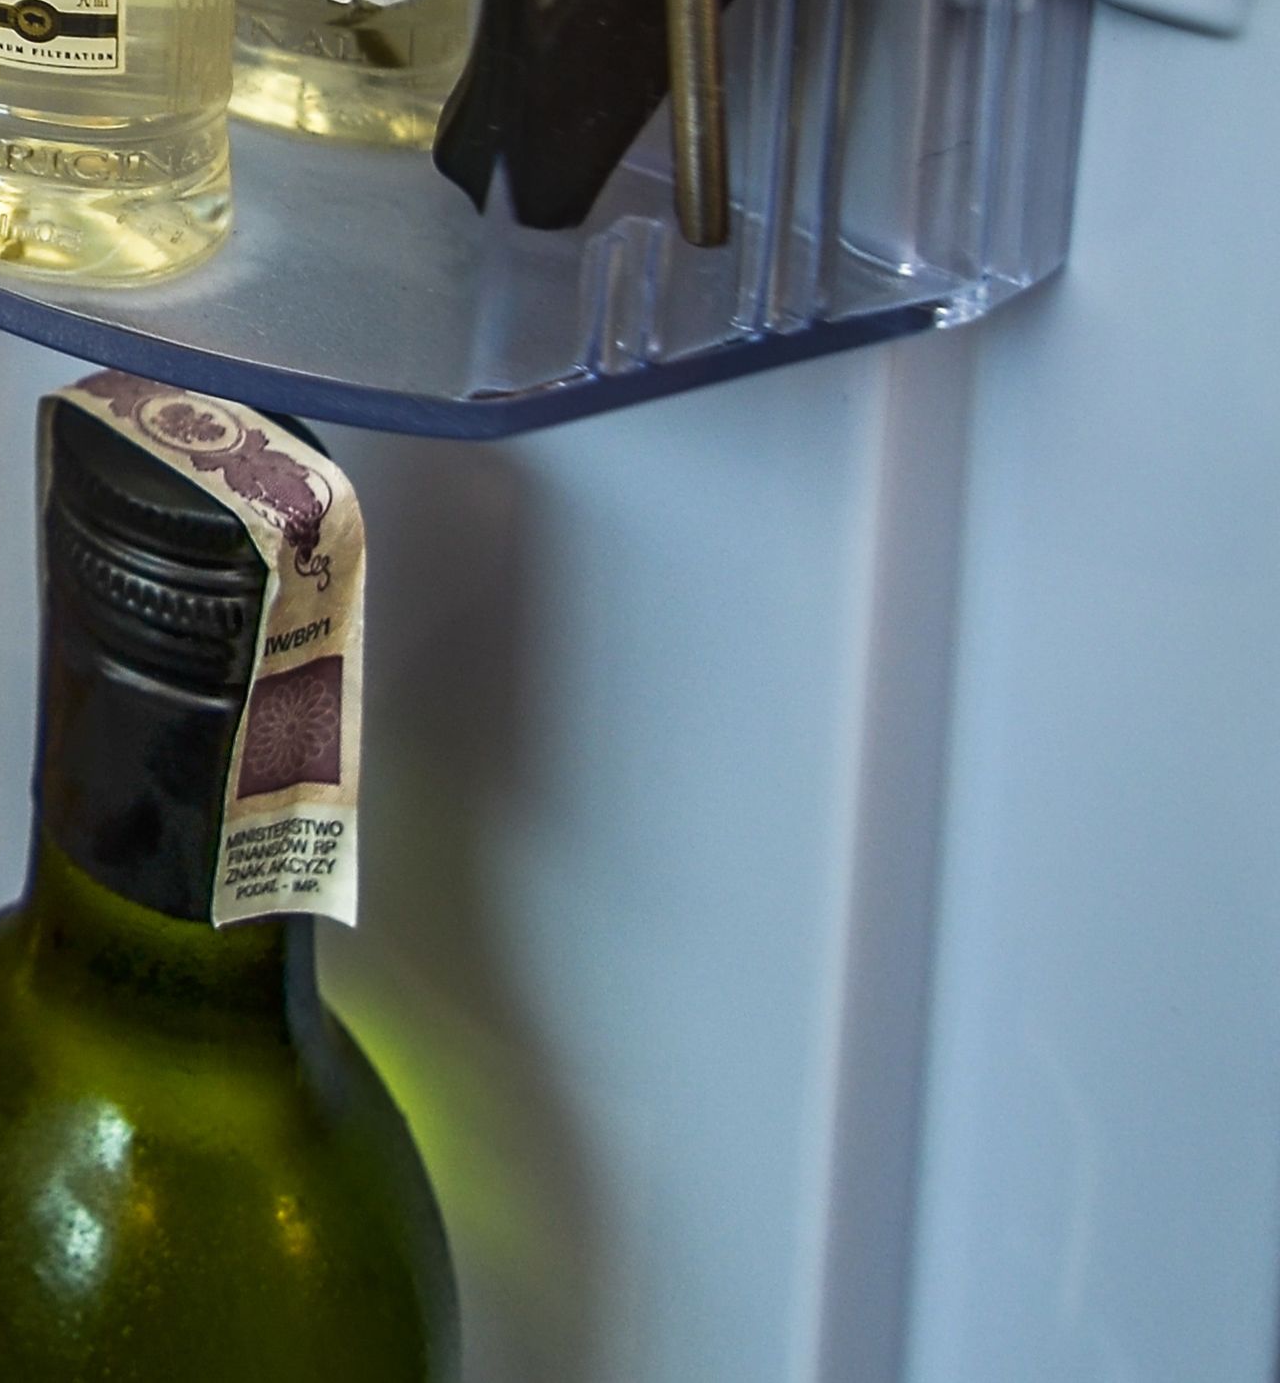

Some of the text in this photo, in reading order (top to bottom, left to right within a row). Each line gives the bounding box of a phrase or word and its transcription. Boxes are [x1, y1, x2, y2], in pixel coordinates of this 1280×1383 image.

[32, 47, 114, 61] FILTRATION
[225, 817, 344, 850] MINISTERSTWO
[227, 835, 338, 867] FINANSÓW RP
[224, 856, 336, 886] ZNAK AKCYZY
